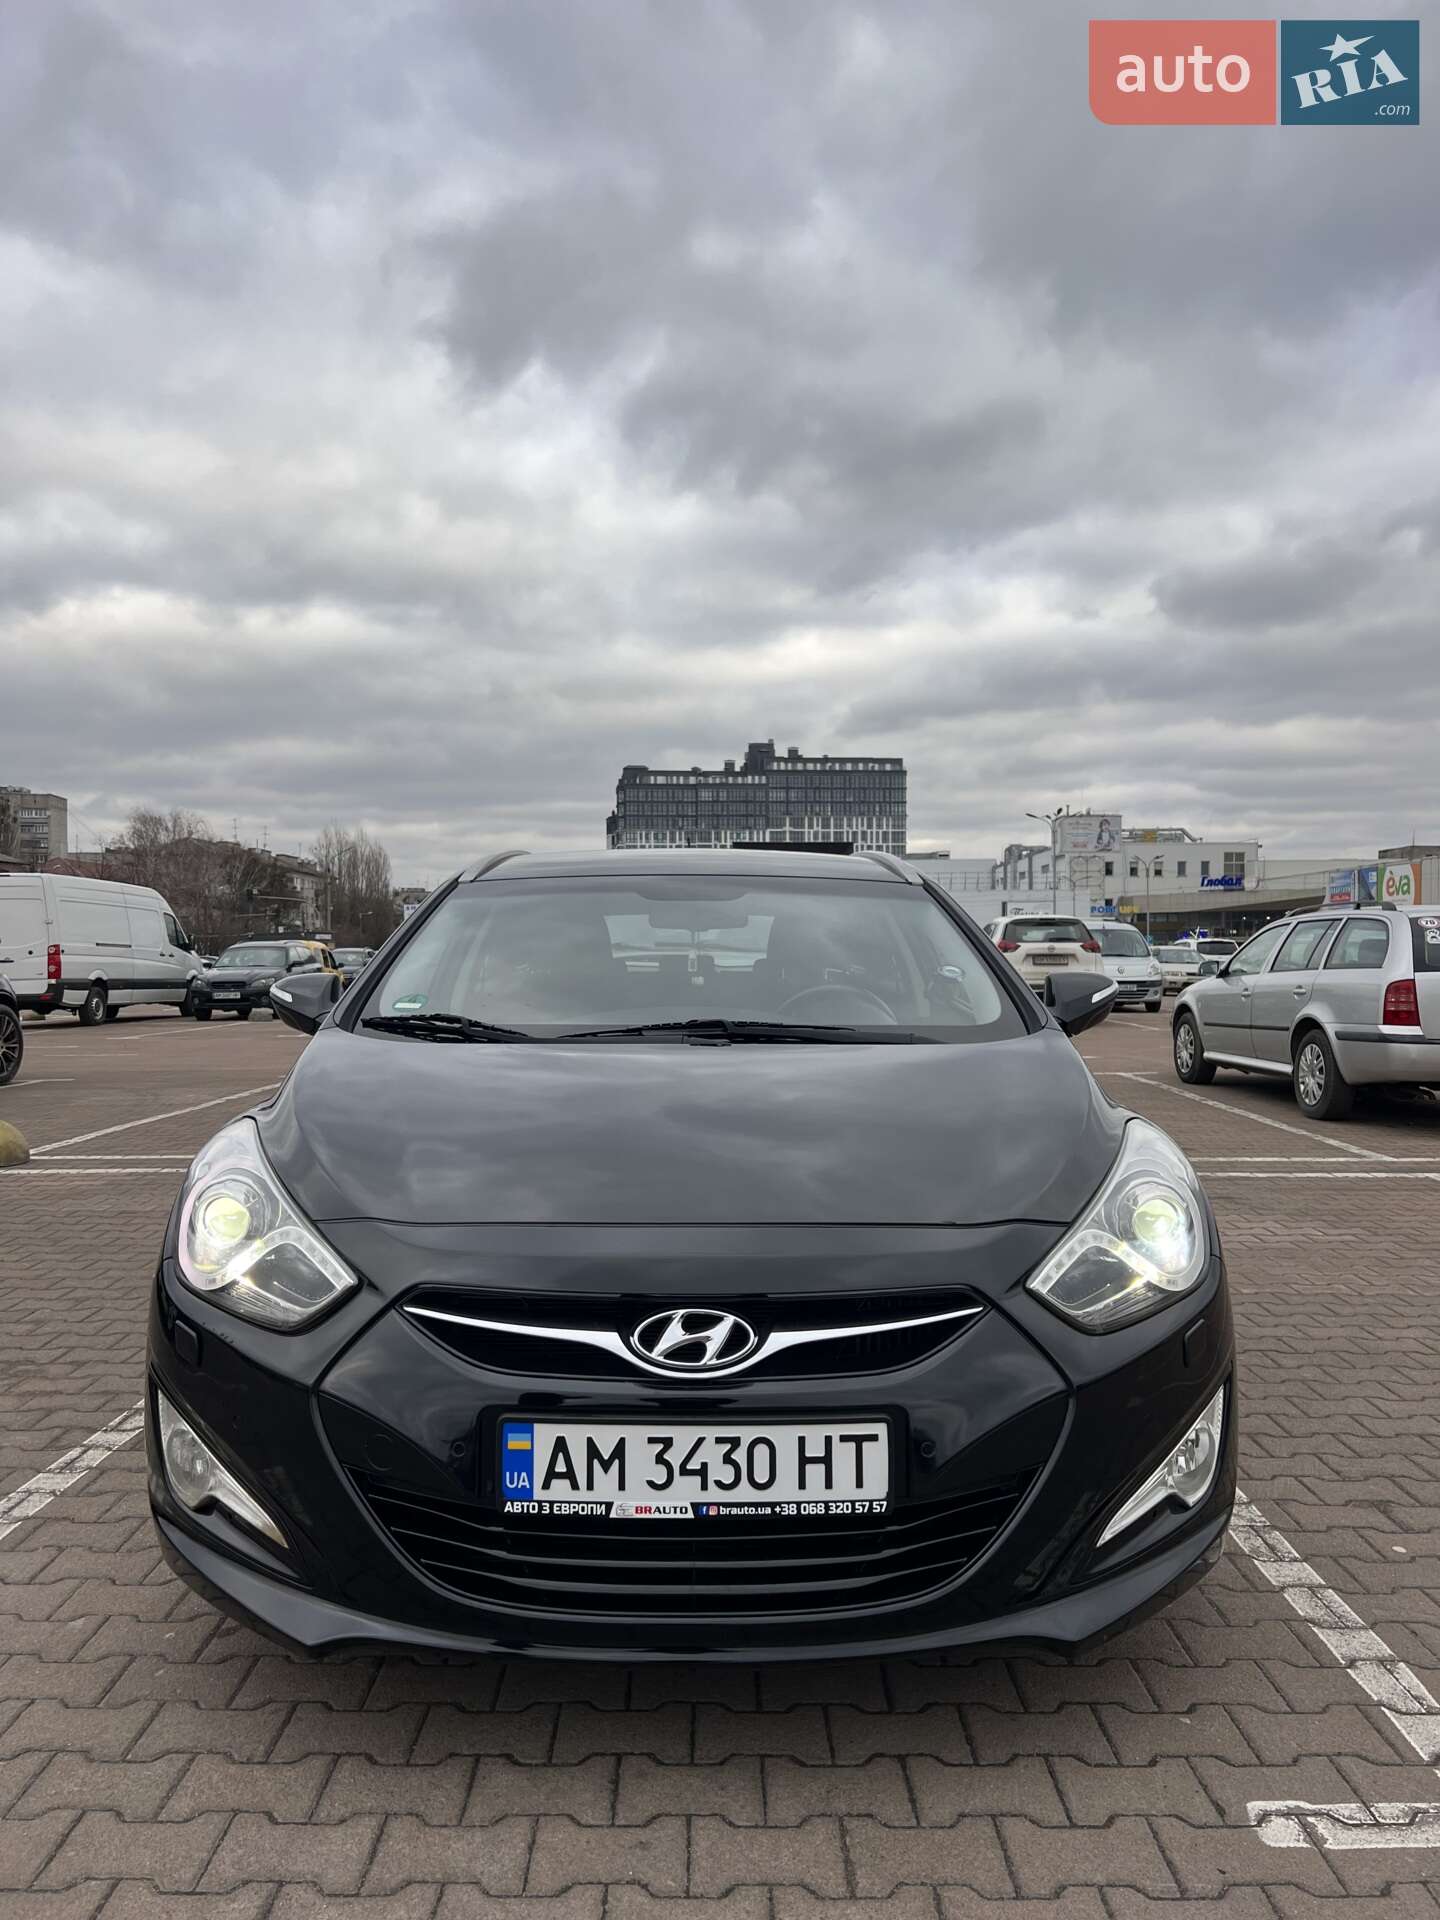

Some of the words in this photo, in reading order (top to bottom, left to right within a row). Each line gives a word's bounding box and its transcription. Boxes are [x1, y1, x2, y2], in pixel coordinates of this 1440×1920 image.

[541, 1435, 626, 1491] AM
[645, 1436, 777, 1492] 3430
[797, 1433, 880, 1490] HT
[505, 1471, 530, 1489] UA
[504, 1501, 538, 1514] АВТО
[553, 1503, 606, 1515] ЄВРОПИ
[634, 1505, 689, 1515] BRAUTO
[719, 1505, 771, 1515] brauto.ua
[774, 1503, 798, 1515] +38
[800, 1502, 825, 1515] 068
[828, 1502, 852, 1514] 320
[855, 1501, 870, 1513] 57
[872, 1501, 887, 1513] 57
